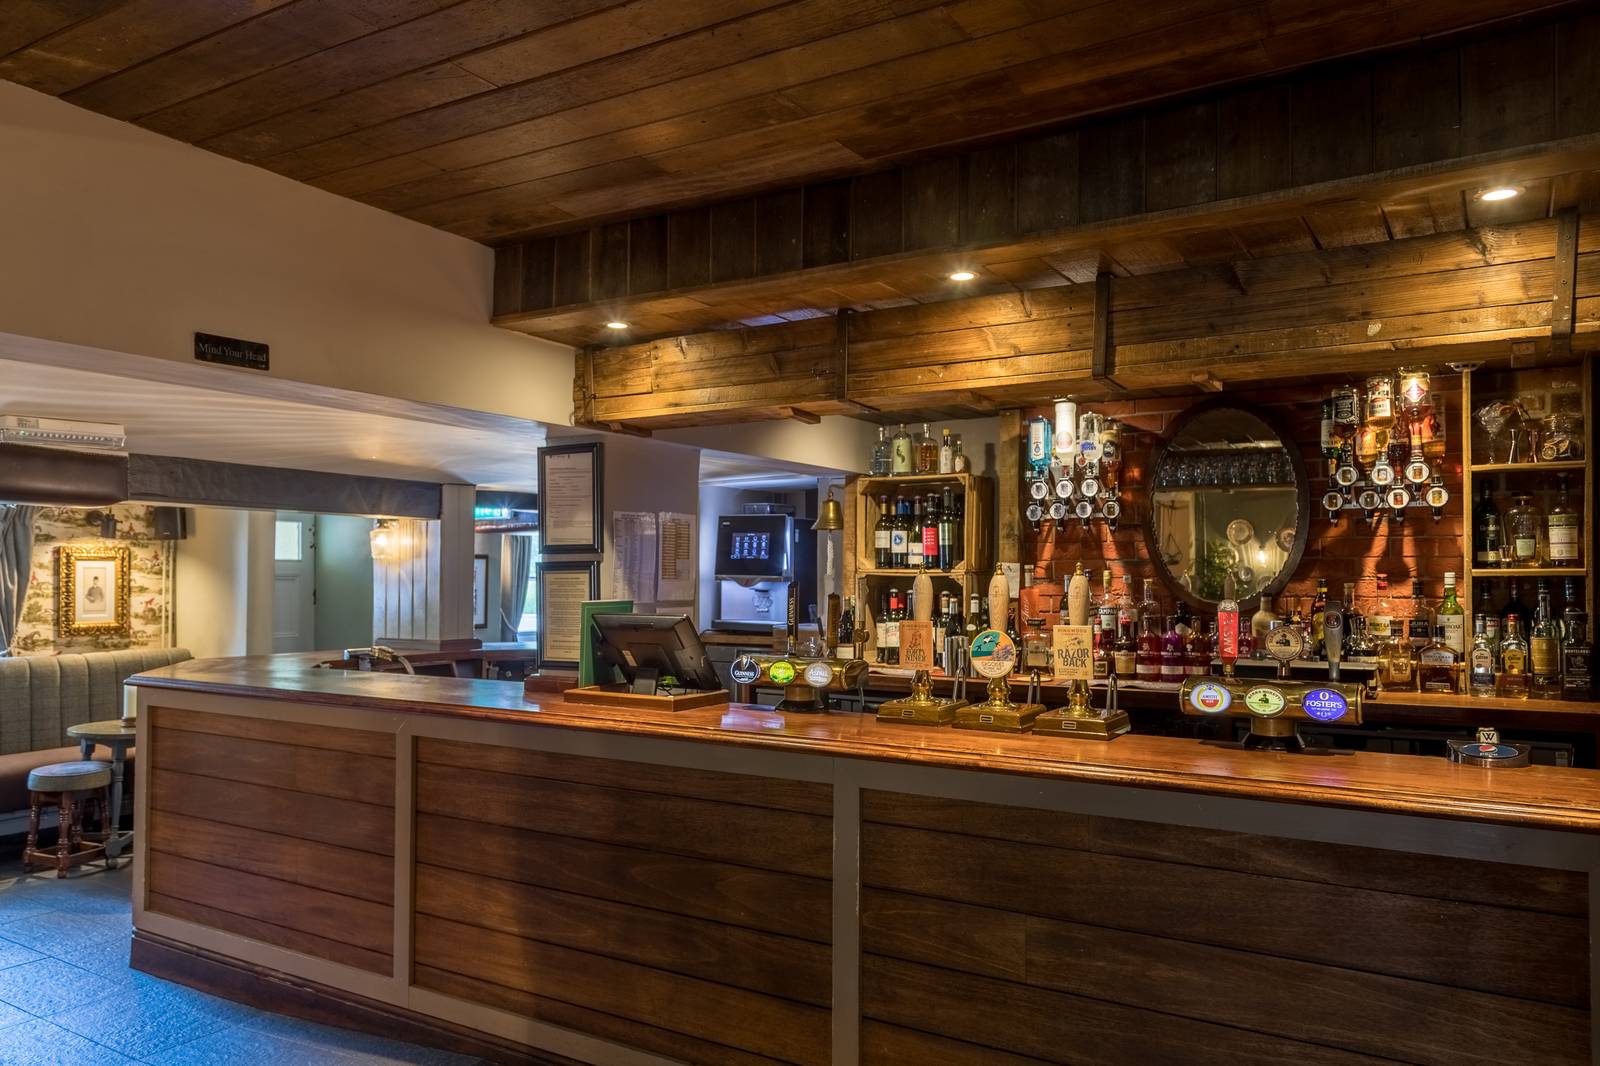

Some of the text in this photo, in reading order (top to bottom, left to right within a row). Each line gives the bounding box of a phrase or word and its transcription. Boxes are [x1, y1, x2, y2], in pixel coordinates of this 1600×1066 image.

[199, 343, 267, 362] Mind Your Head
[1057, 648, 1090, 659] RAZOR
[1063, 658, 1087, 668] BACK
[1306, 700, 1343, 709] FOSTER'S
[1481, 732, 1495, 741] W
